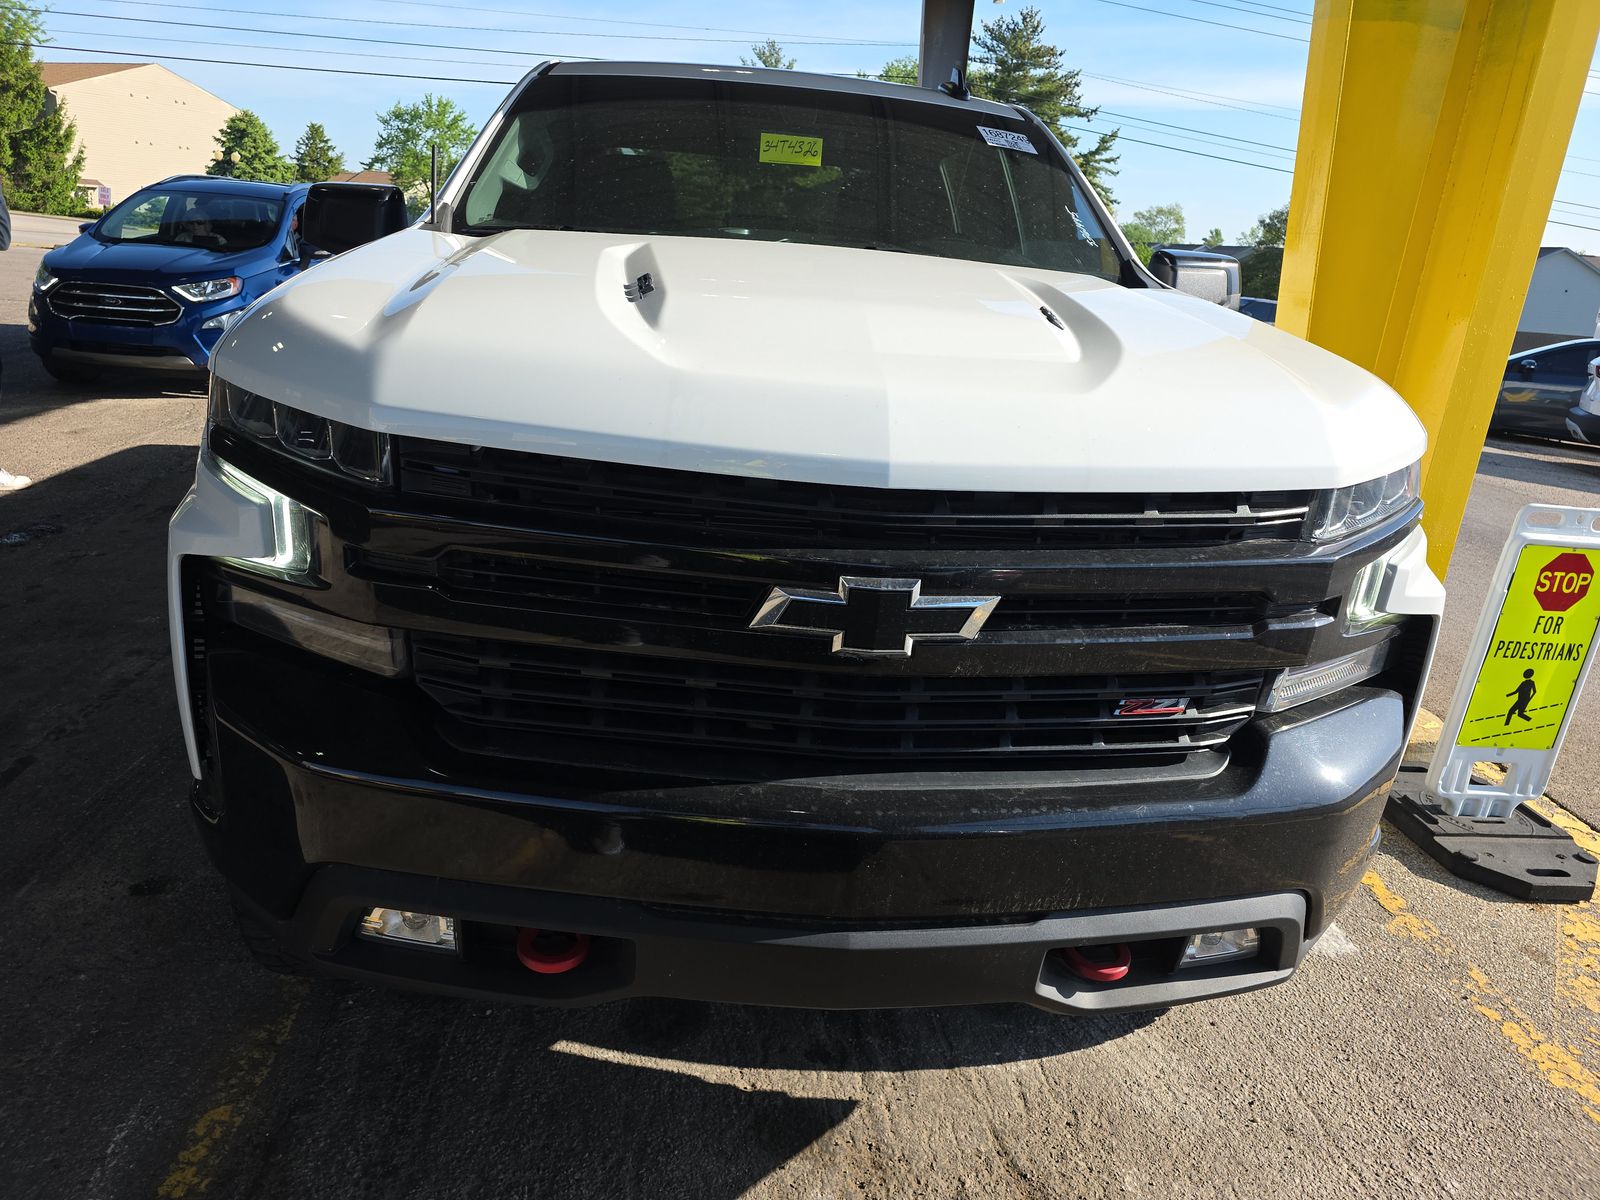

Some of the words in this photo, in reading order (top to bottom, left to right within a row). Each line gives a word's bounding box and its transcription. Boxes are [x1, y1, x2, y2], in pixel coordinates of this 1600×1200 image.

[762, 140, 818, 157] 34T4326
[1537, 571, 1592, 593] STOP
[1533, 615, 1564, 635] FOR
[1493, 640, 1583, 661] PEDESTRIANS
